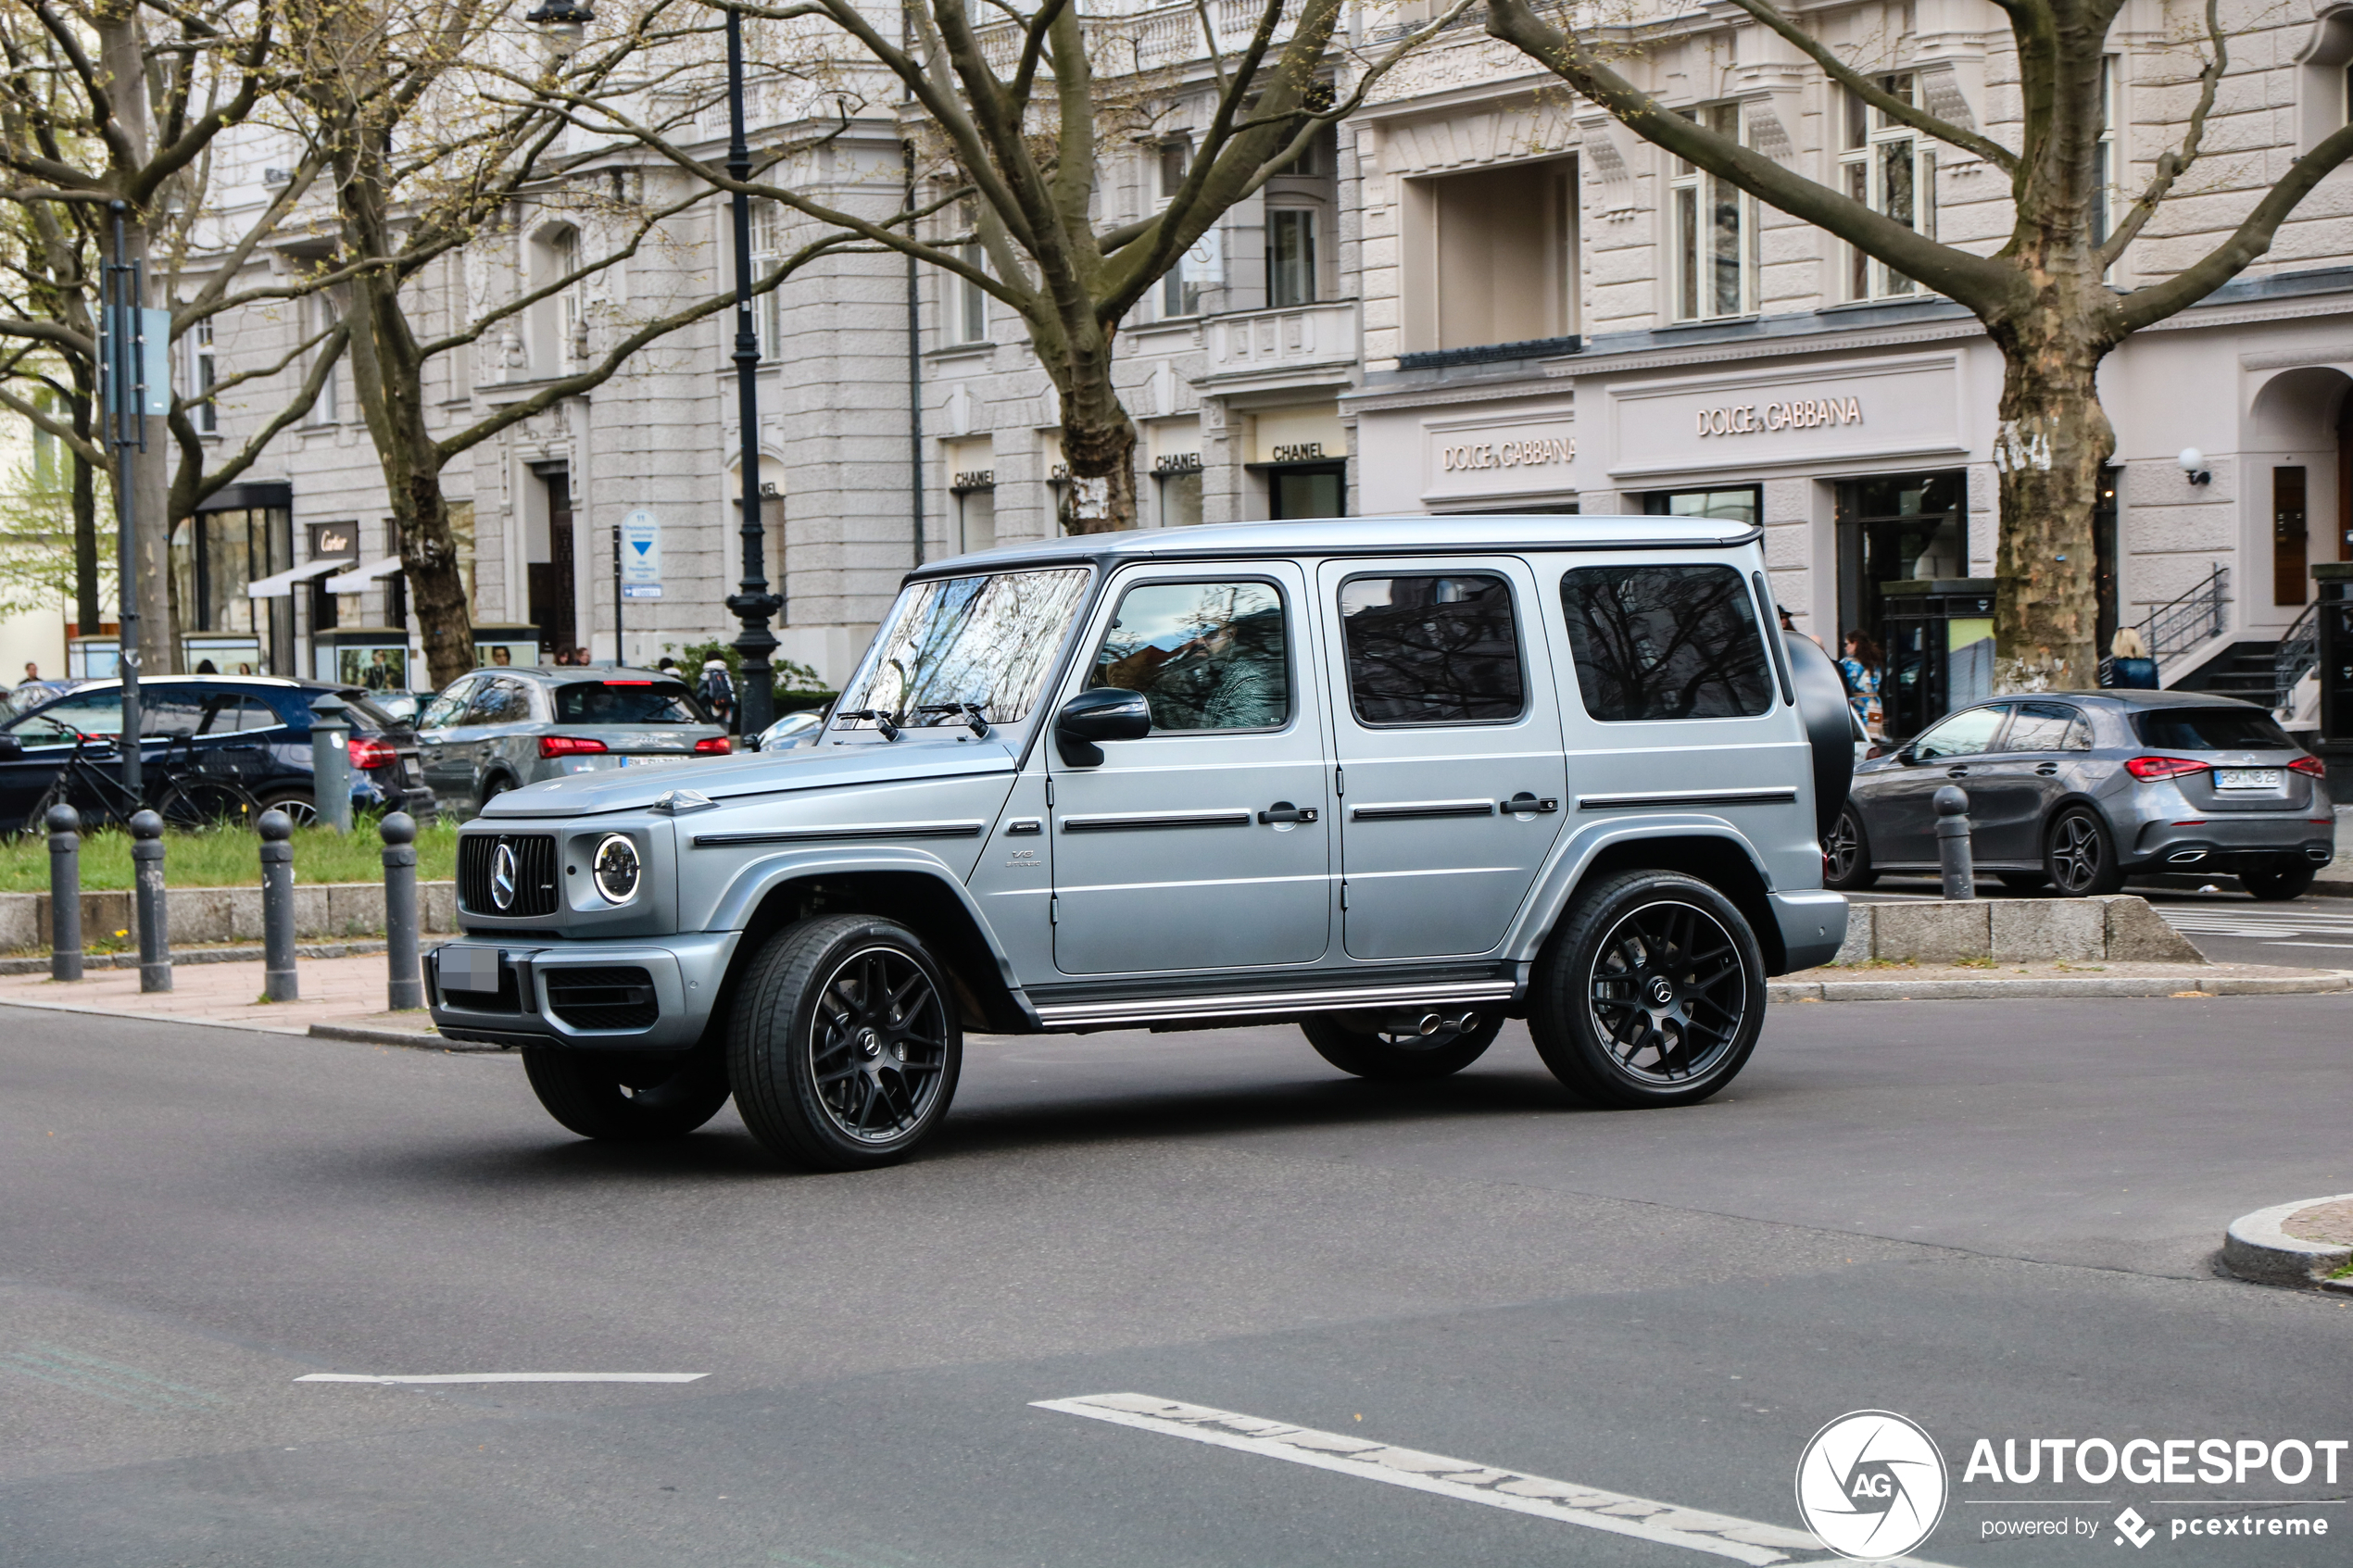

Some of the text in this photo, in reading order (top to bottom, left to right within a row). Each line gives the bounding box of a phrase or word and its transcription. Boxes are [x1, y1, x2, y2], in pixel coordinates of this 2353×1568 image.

[1696, 405, 1755, 436] DOLCE
[1765, 395, 1863, 431] GABBANA
[1155, 453, 1202, 470] CHANEL
[1273, 443, 1326, 461] CHANEL
[1442, 444, 1491, 470] DOLCE
[1500, 437, 1577, 467] GABBANA
